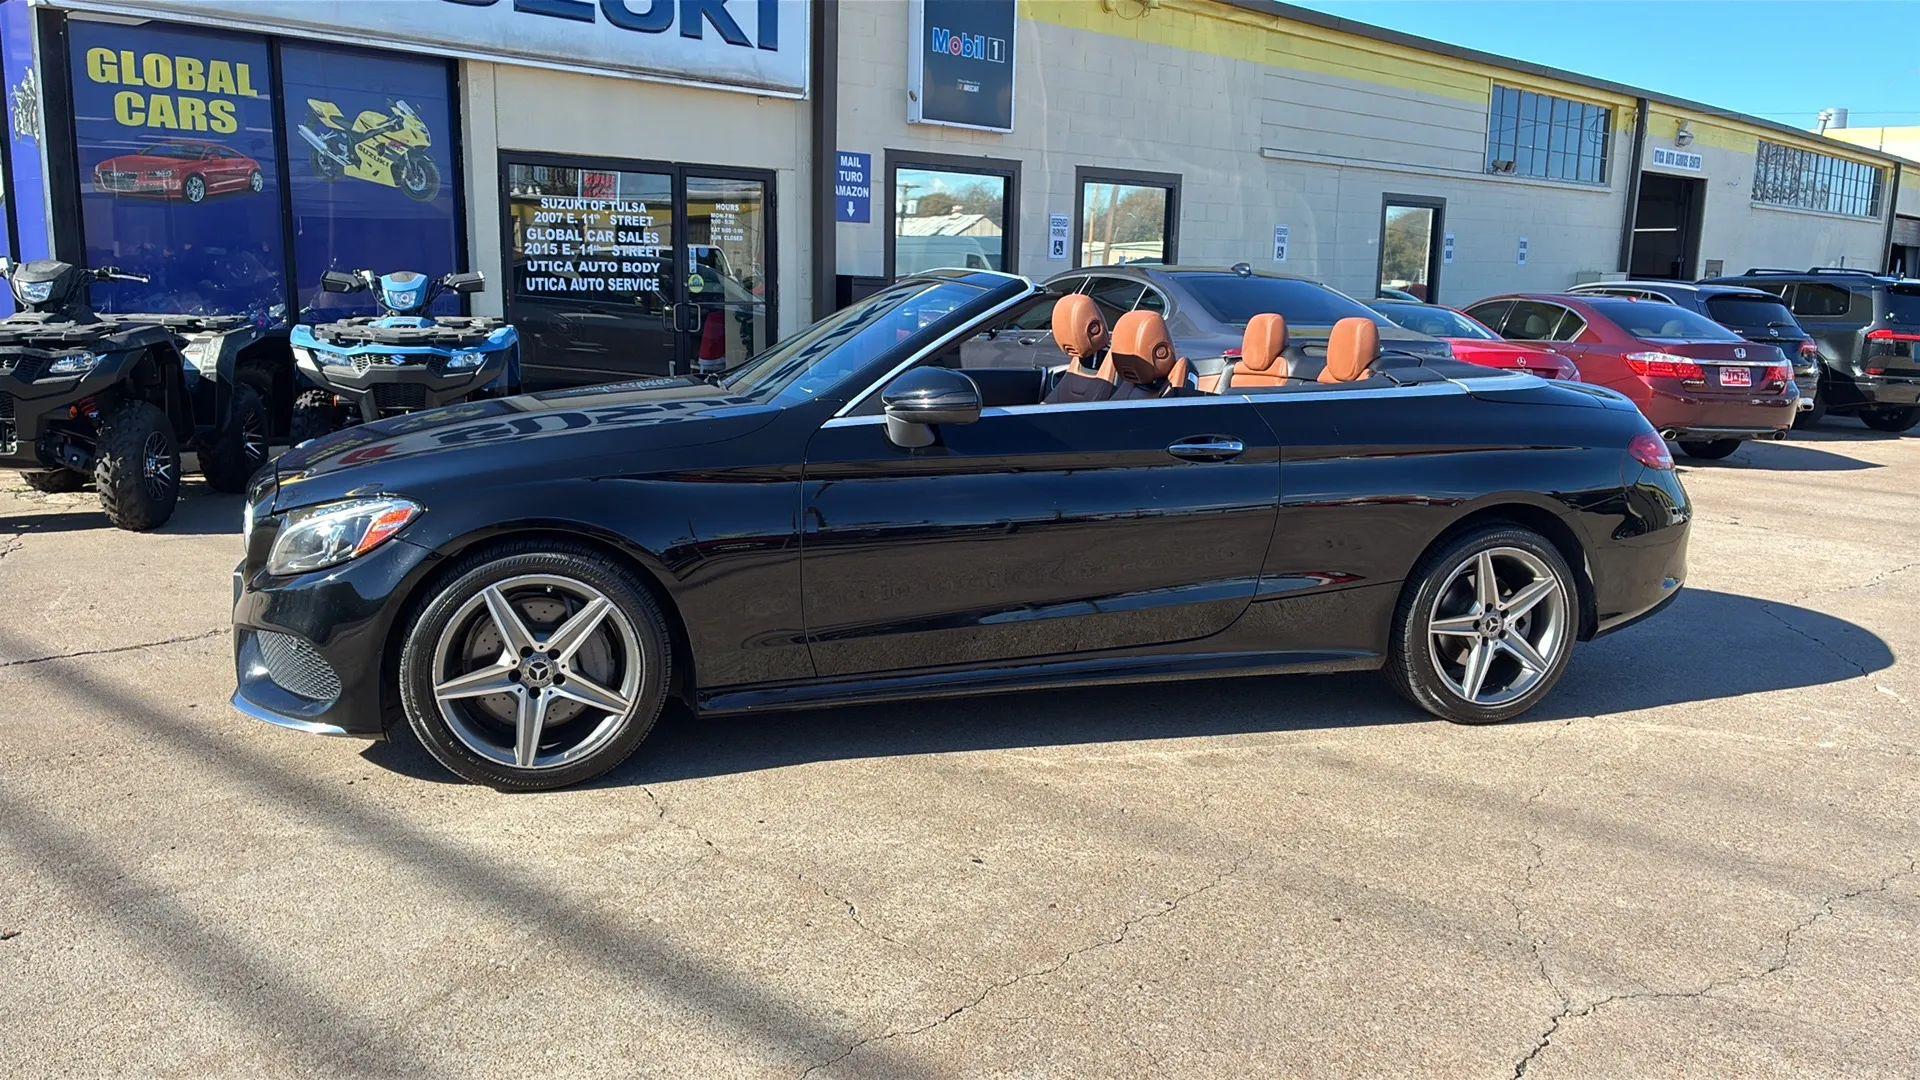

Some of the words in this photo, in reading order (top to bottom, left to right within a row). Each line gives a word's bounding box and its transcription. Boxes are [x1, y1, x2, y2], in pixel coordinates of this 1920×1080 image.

[932, 27, 985, 60] Mobil
[86, 47, 259, 98] GLOBAL
[113, 91, 239, 134] CARS
[357, 144, 389, 167] SUZUKI
[840, 155, 861, 168] MAIL
[839, 170, 863, 183] TURO
[541, 198, 587, 211] SUZUKI
[590, 200, 606, 211] OF
[609, 201, 647, 214] TULSA
[715, 203, 740, 212] HOURS
[534, 211, 563, 223] 2007
[566, 213, 578, 224] E.
[610, 215, 653, 226] STREET
[526, 228, 583, 241] GLOBAL
[586, 230, 615, 243] CAR
[618, 232, 659, 244] SALES
[524, 242, 557, 255] 2015
[562, 243, 575, 256] E.
[612, 245, 661, 257] STREET
[526, 260, 574, 272] UTICA
[578, 261, 618, 273] AUTO
[622, 262, 661, 273] BODY
[526, 277, 568, 291] UTICA
[570, 278, 605, 291] AUTO
[608, 278, 660, 291] SERVICE
